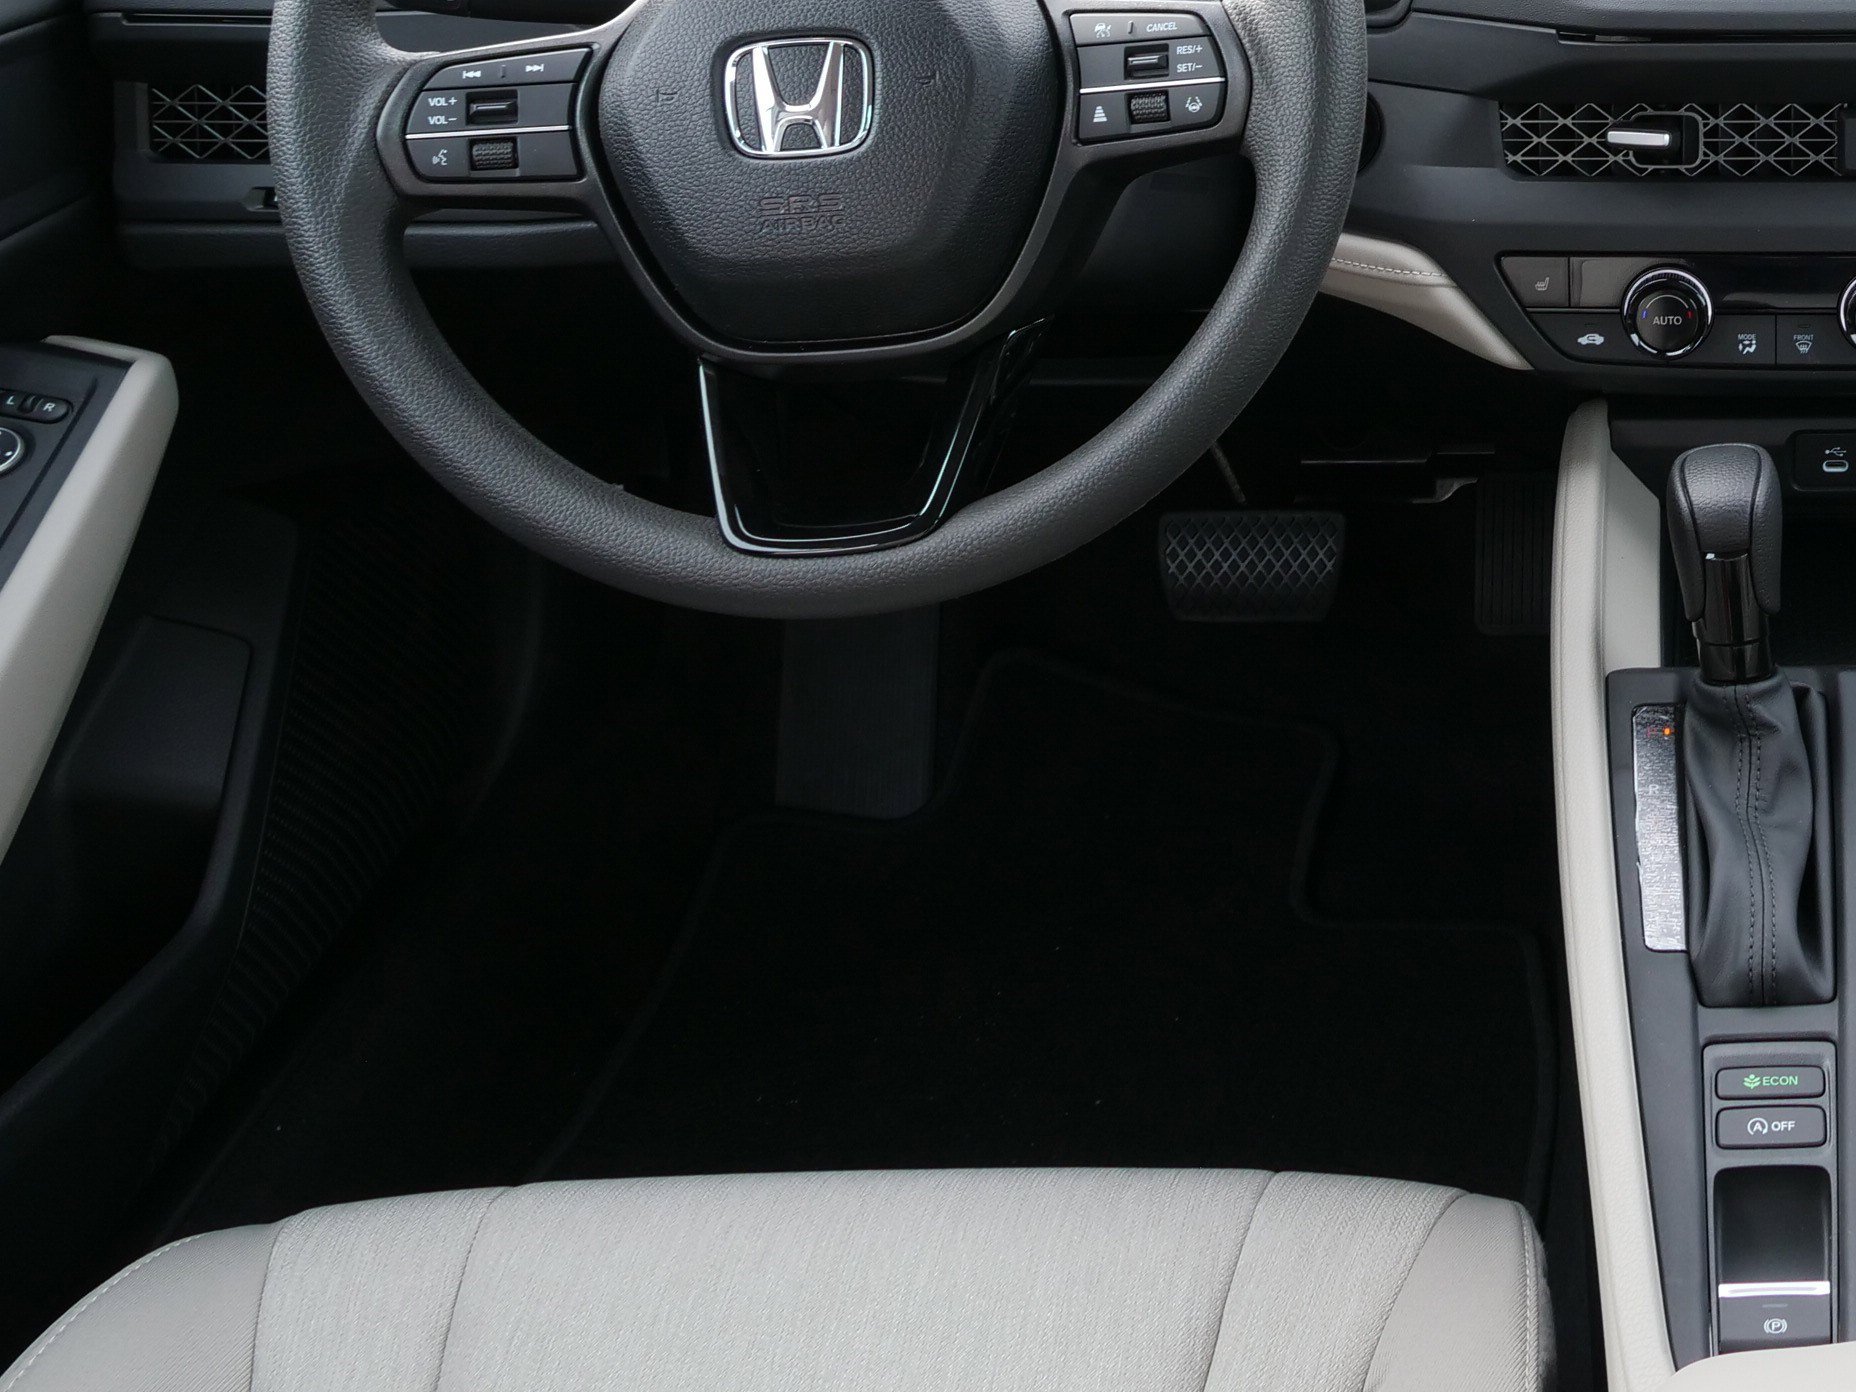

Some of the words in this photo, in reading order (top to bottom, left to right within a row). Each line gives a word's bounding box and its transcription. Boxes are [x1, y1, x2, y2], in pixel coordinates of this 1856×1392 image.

[1146, 22, 1178, 32] CANCEL
[1176, 45, 1203, 55] RES/+
[428, 97, 458, 107] VOL+
[759, 193, 842, 215] SRS
[1652, 315, 1683, 327] AUTO
[1737, 334, 1757, 342] MODE
[1793, 334, 1814, 342] FRONT
[6, 396, 14, 405] L
[43, 402, 56, 412] R
[1649, 784, 1659, 794] R
[1762, 1076, 1798, 1086] ECON
[1771, 1120, 1796, 1131] OFF
